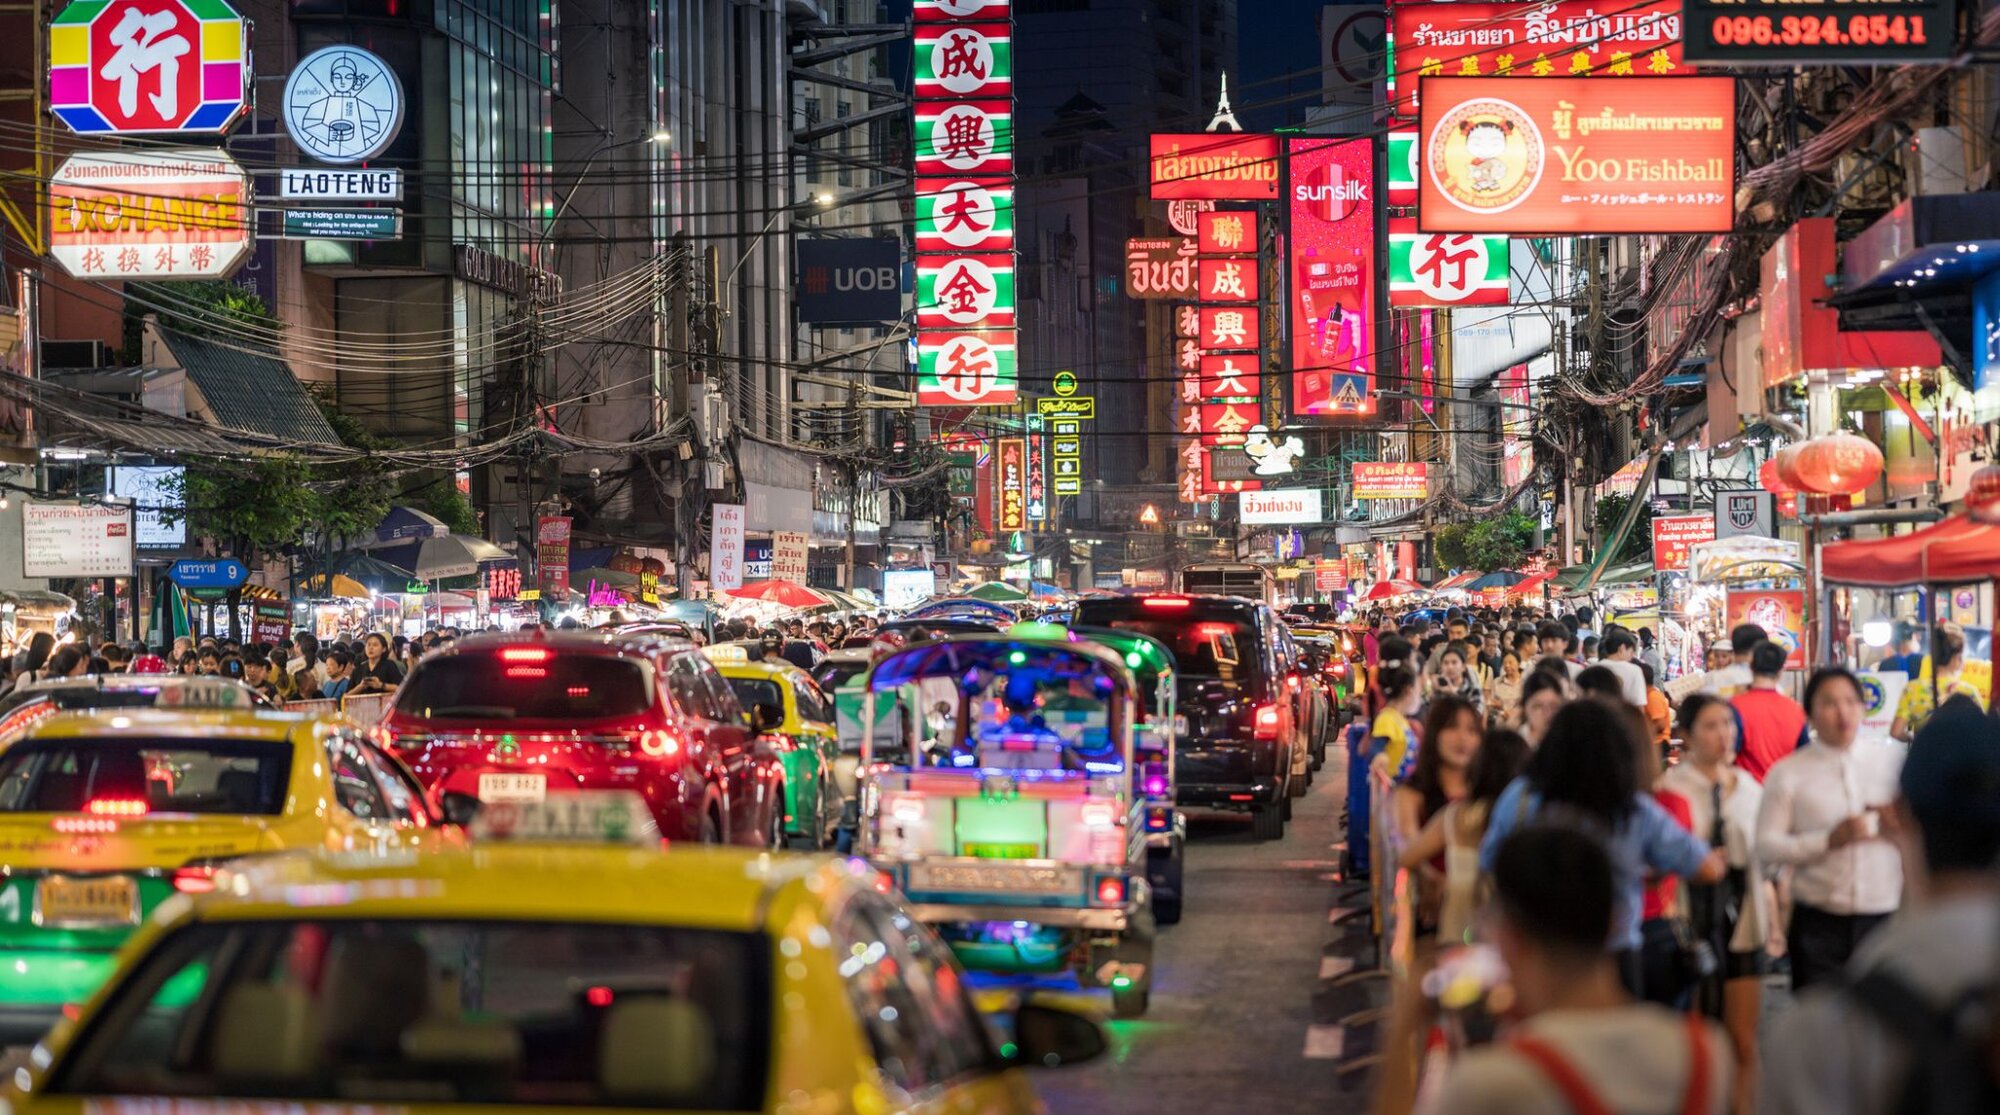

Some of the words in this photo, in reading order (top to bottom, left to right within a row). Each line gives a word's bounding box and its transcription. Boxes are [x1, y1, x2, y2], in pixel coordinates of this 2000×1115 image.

[1412, 23, 1515, 47] ร้านขายยา
[1712, 15, 1926, 46] 096.324.6541
[100, 6, 191, 121] 行
[1625, 158, 1723, 182] Fishball
[289, 174, 391, 194] LAOTENG
[1296, 180, 1368, 201] sunsilk
[53, 193, 239, 234] EXCHANGE
[288, 210, 311, 219] What's
[1415, 233, 1479, 291] 行
[835, 267, 896, 291] UOB
[178, 563, 216, 574] เยาวราช
[228, 565, 237, 580] 9
[747, 564, 760, 575] 24
